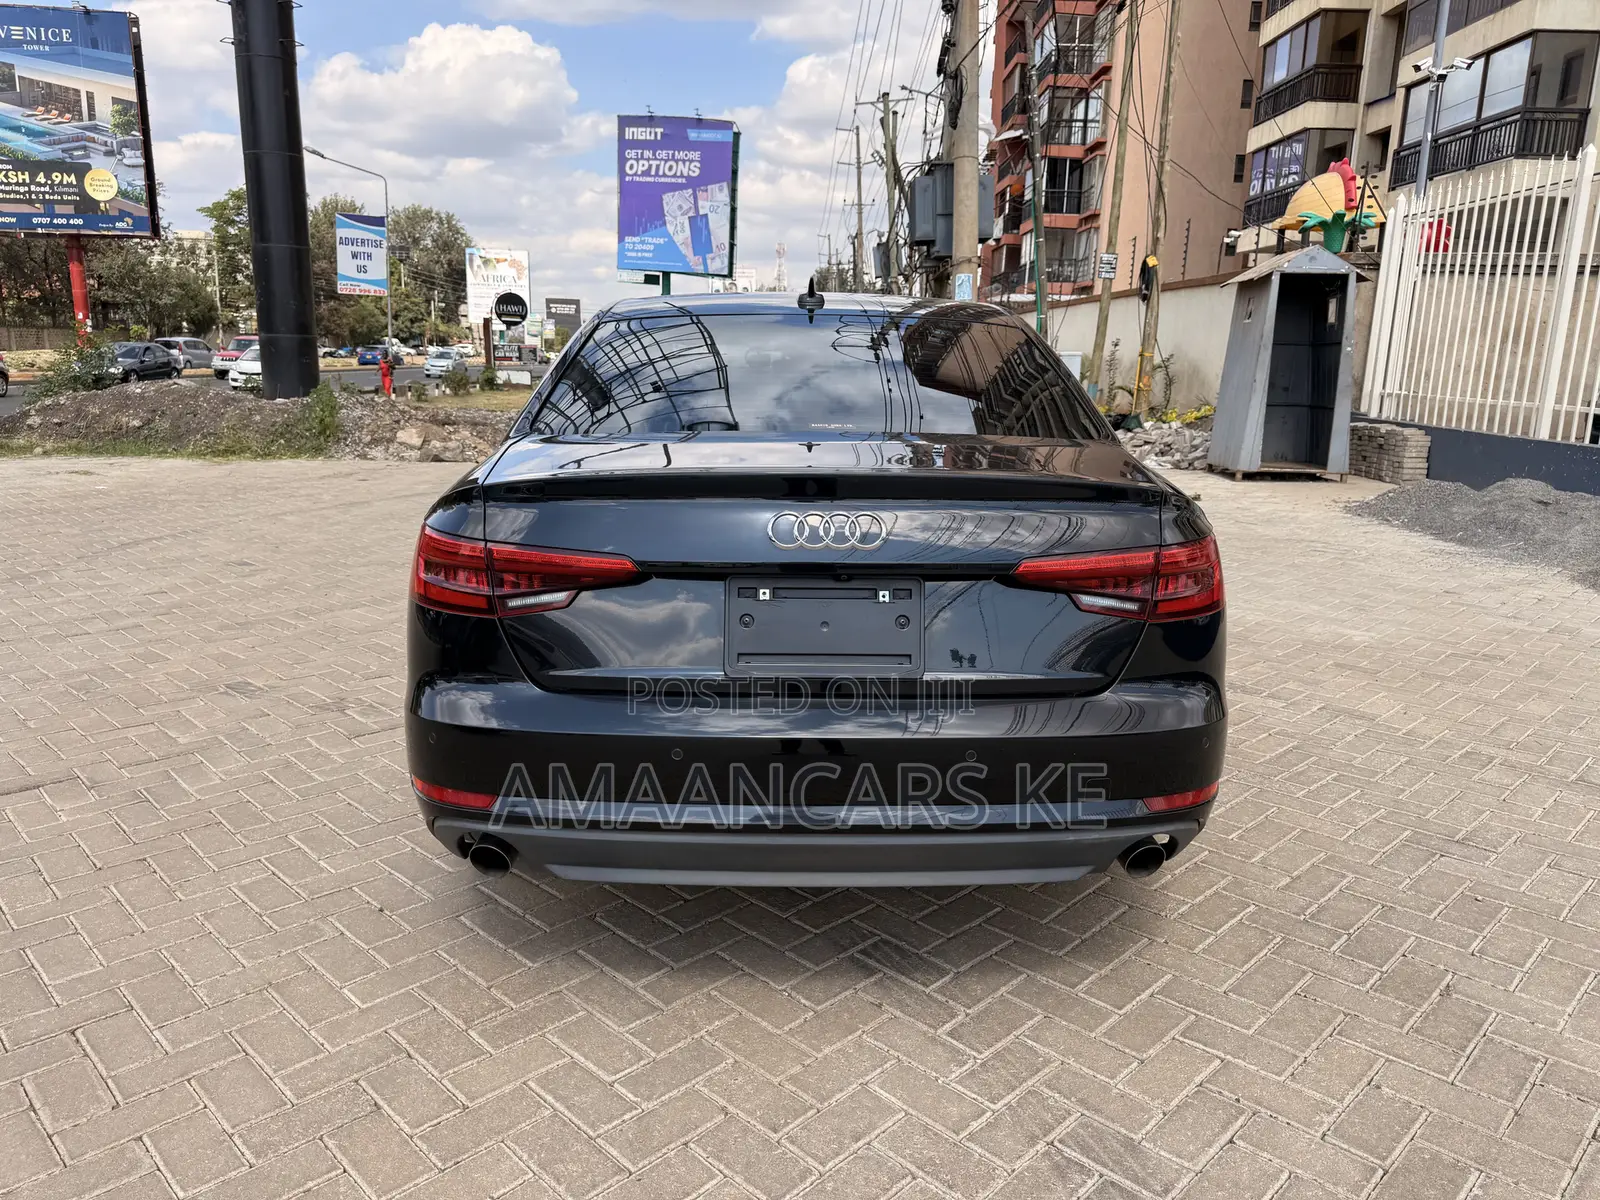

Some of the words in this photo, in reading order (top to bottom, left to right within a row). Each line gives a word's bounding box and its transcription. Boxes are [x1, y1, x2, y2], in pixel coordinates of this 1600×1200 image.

[625, 150, 642, 158] GET
[644, 150, 655, 159] IN.
[656, 150, 674, 159] GET
[675, 151, 701, 160] MORE
[625, 160, 701, 177] OPTIONS
[0, 170, 30, 183] KSH
[35, 172, 77, 185] 4.9M
[339, 237, 384, 249] ADVERTISE
[351, 251, 372, 261] WITH
[356, 264, 368, 274] US
[480, 274, 517, 284] AFRICA
[500, 304, 522, 313] HAWI
